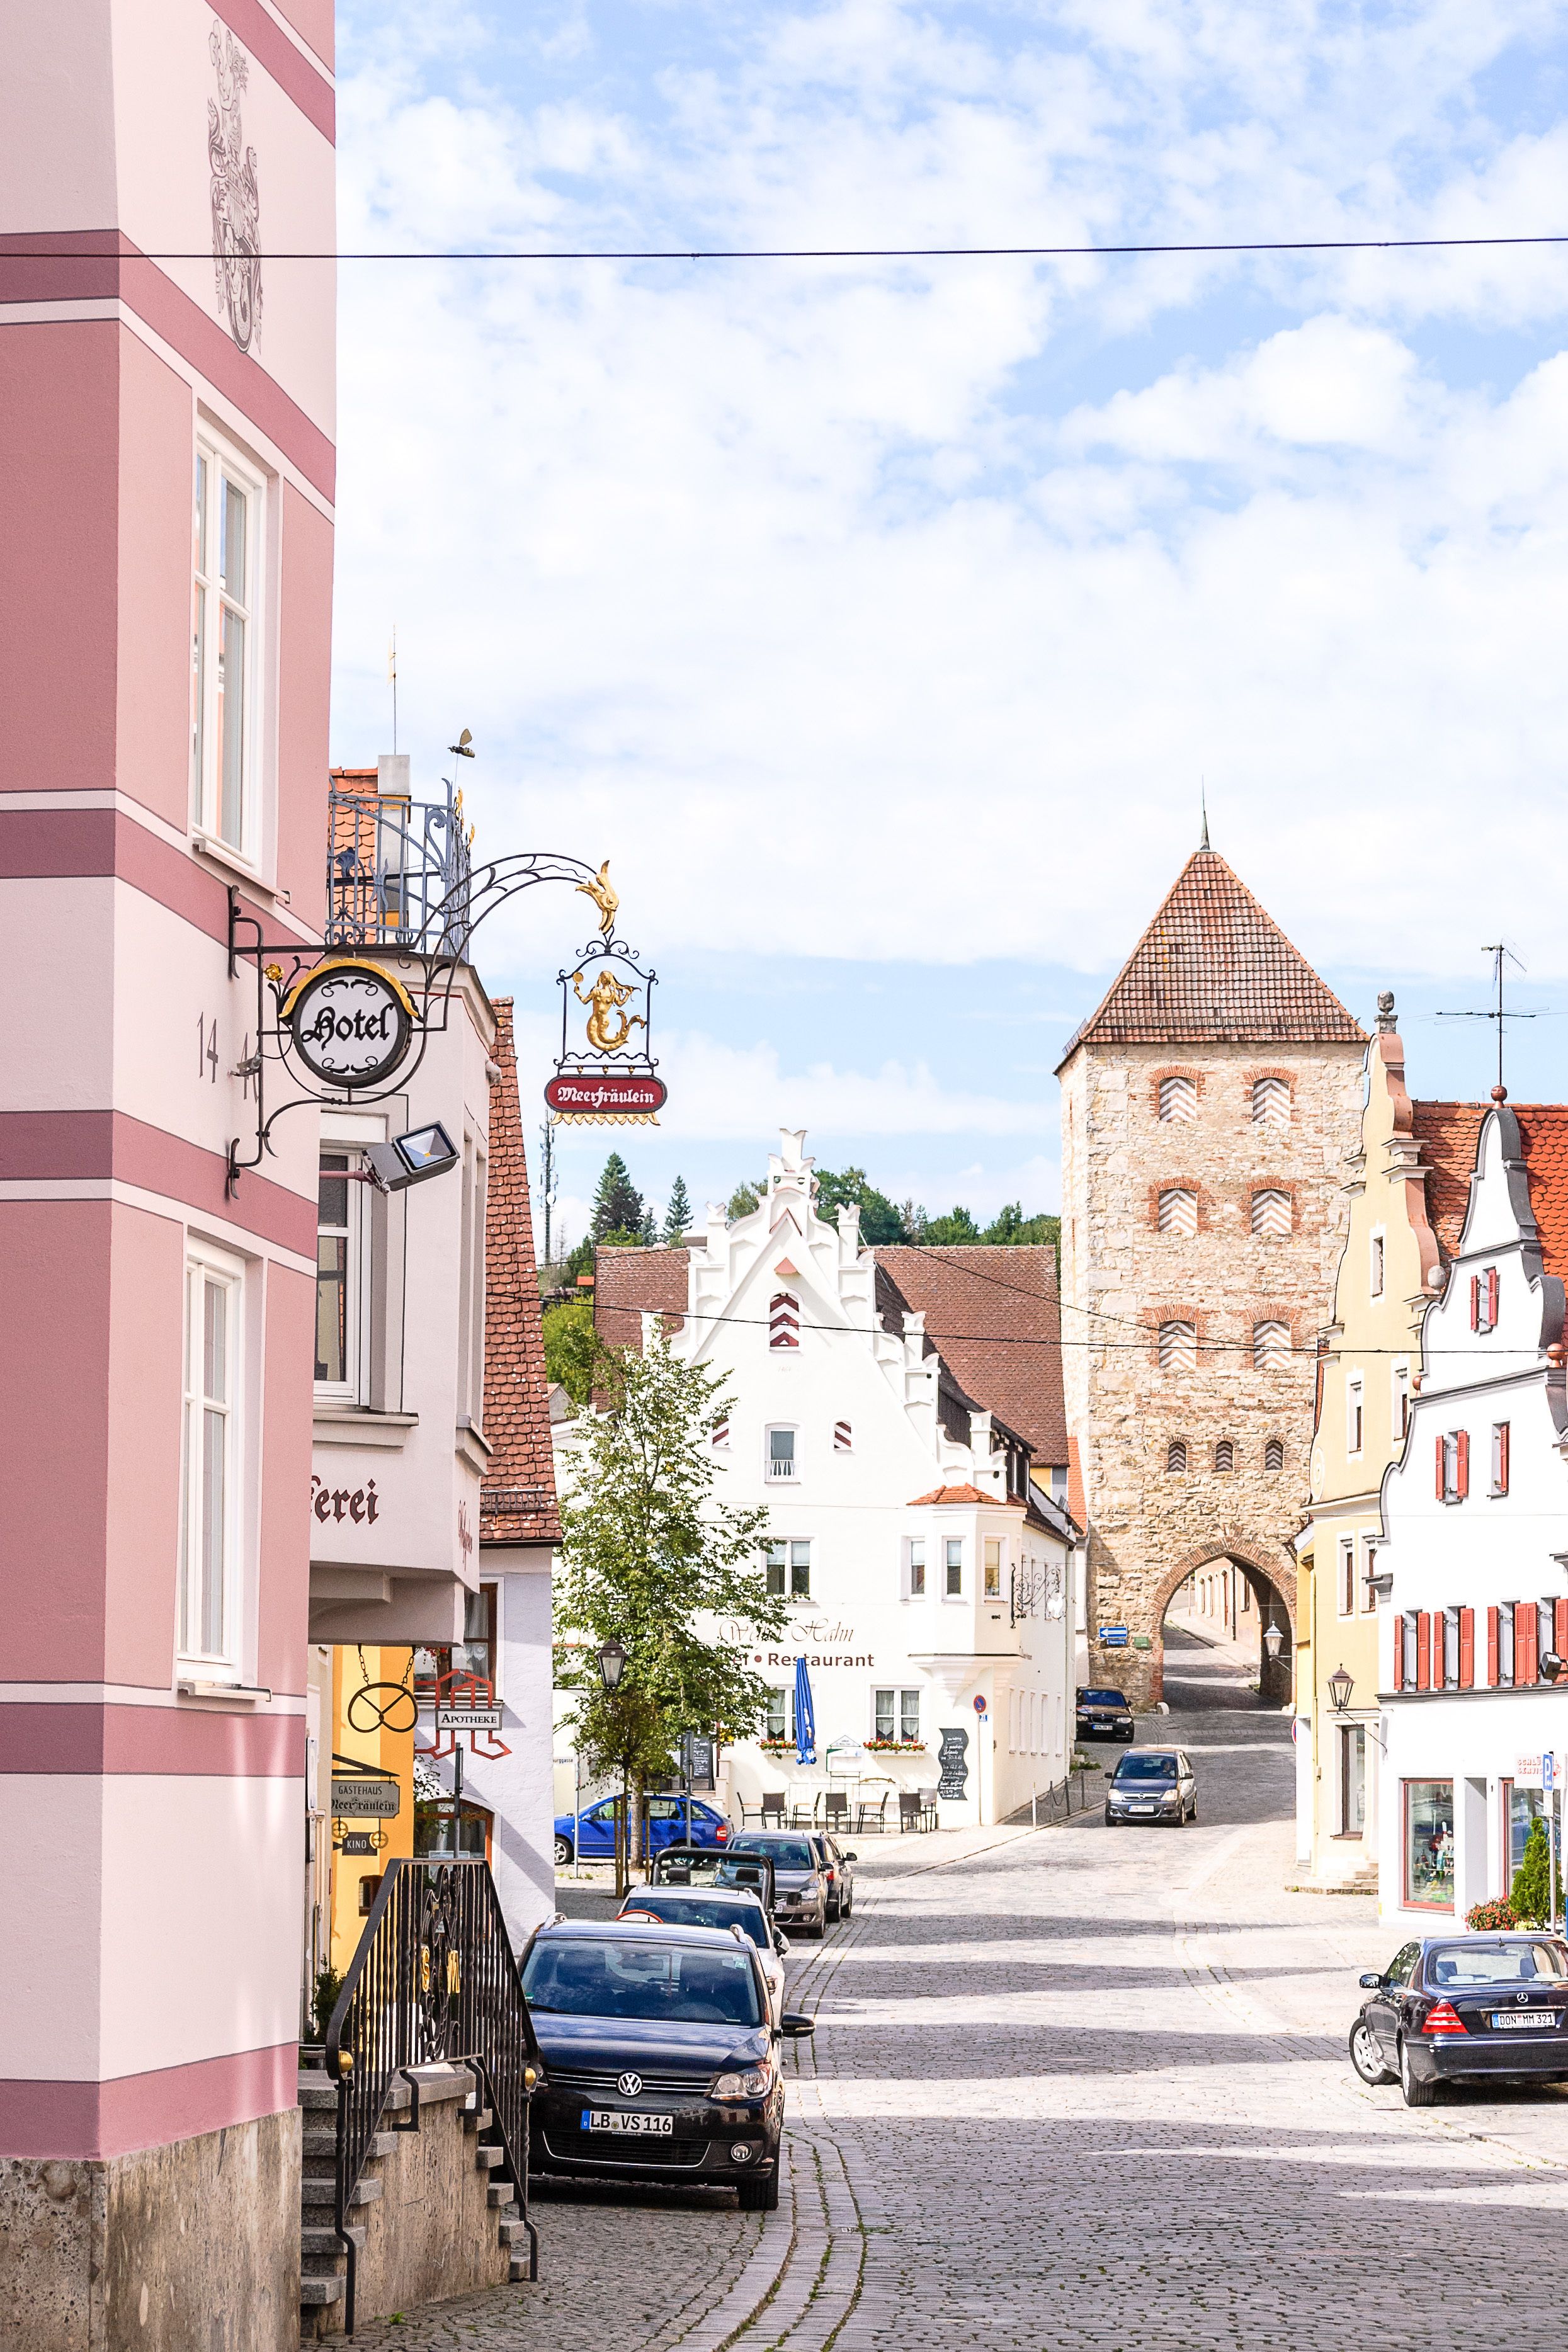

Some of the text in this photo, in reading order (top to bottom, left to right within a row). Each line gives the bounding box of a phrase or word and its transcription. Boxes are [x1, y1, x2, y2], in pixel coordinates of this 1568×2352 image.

[300, 1003, 396, 1052] Hotel
[557, 1086, 655, 1108] Meerfräulein
[791, 1618, 854, 1642] Hahn
[768, 1652, 875, 1667] Restaurant
[441, 1713, 497, 1724] APOTHEKE
[347, 1839, 366, 1849] KINO
[1499, 2015, 1516, 2025] DON
[1523, 2014, 1535, 2025] MM
[1537, 2014, 1553, 2024] 321
[591, 2113, 671, 2132] LB VS 116
